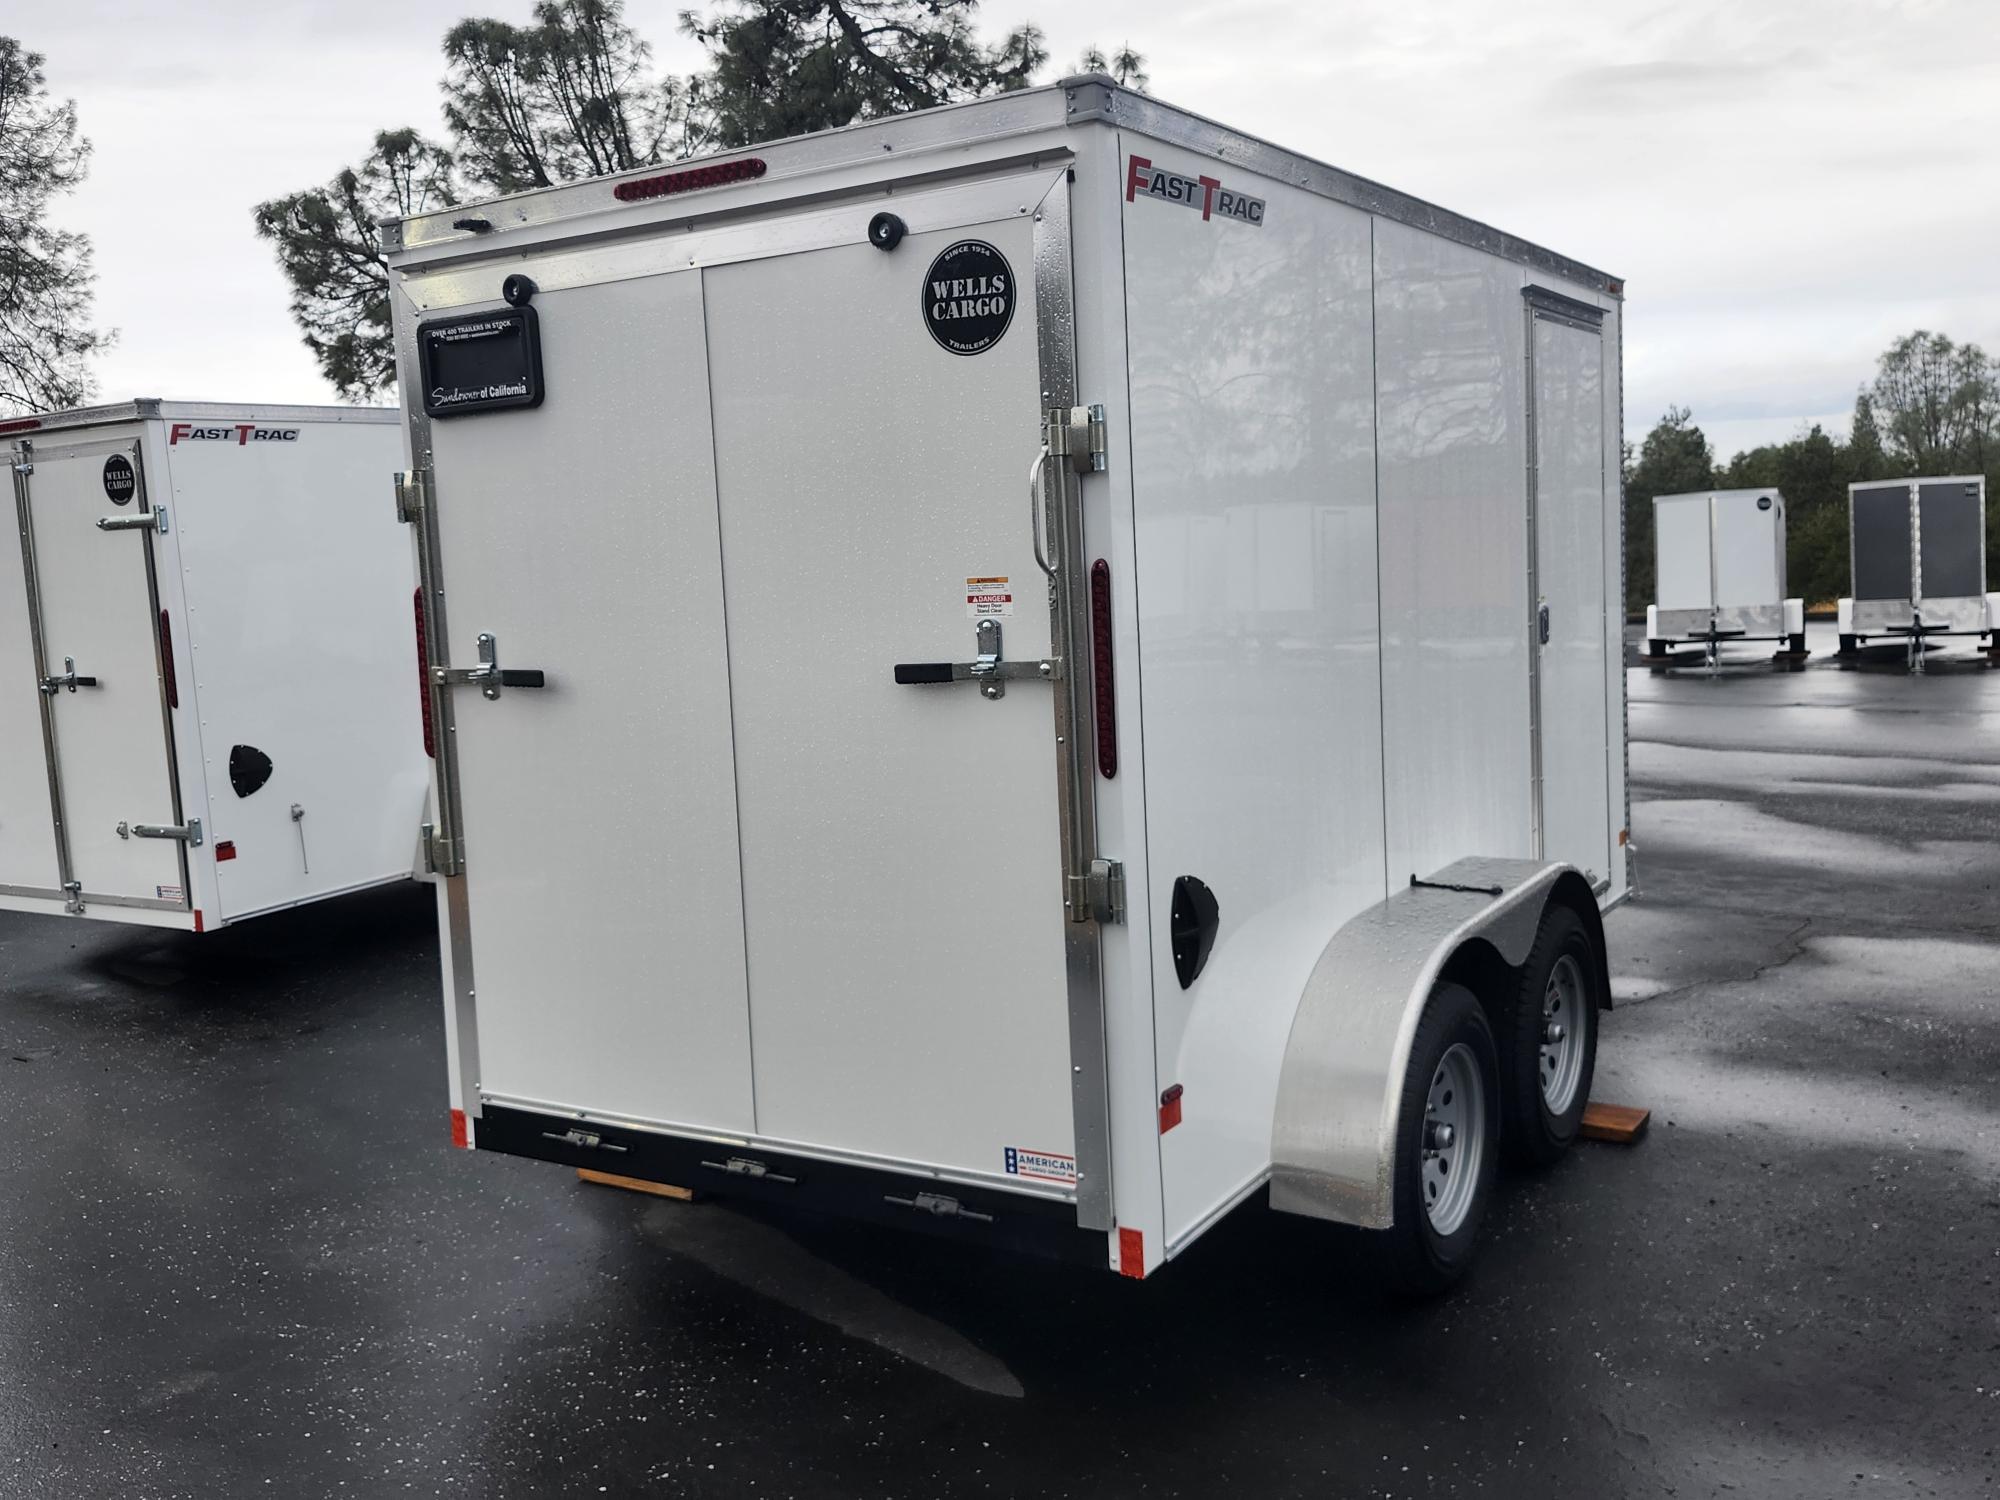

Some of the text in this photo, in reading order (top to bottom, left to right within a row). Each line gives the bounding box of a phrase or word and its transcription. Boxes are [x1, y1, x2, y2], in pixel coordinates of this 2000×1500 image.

[1126, 154, 1262, 222] FAST TRAC
[944, 246, 969, 261] SINCE
[932, 274, 1005, 299] WELLS
[932, 296, 1005, 320] CARGO
[431, 328, 447, 338] OVER
[458, 323, 484, 334] TRAILERS
[485, 322, 491, 330] IN
[492, 320, 511, 330] STOCK
[949, 336, 990, 350] TRAILERS
[480, 387, 488, 399] of
[489, 382, 527, 398] California
[170, 424, 297, 445] FAST TRAC
[106, 470, 131, 480] WELLS
[107, 479, 132, 490] CARGO
[1018, 1155, 1074, 1170] AMERICAN
